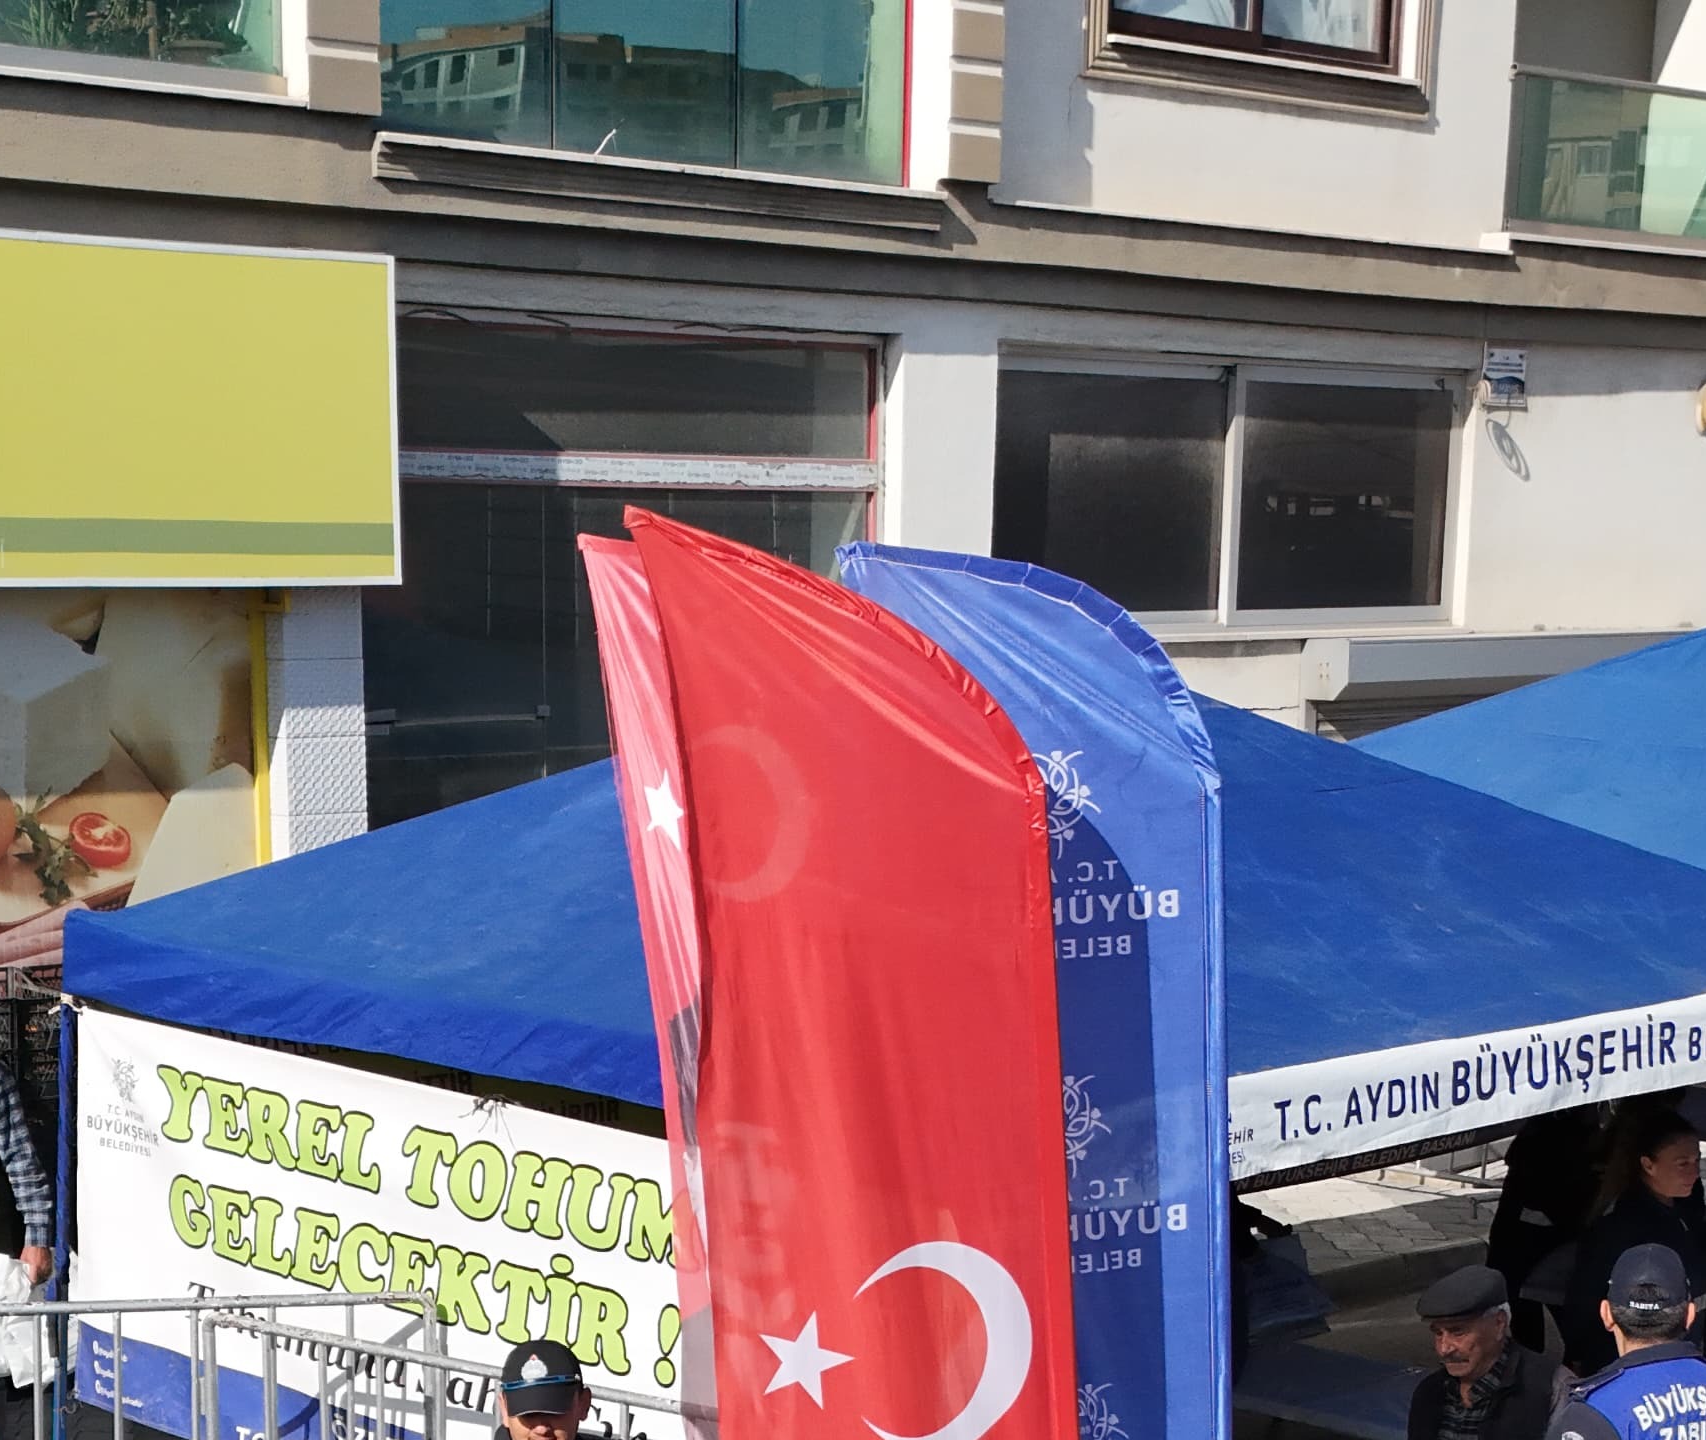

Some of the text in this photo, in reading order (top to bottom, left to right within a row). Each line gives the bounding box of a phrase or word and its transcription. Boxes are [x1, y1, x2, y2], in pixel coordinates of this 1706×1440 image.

[87, 1114, 160, 1148] BÜYÜKŞEHİR
[156, 1063, 381, 1194] YEREL
[1274, 1094, 1333, 1141] T.C.
[1344, 1072, 1440, 1129] AYDIN
[1451, 1014, 1677, 1107] BÜYÜKŞEHİR
[168, 1174, 631, 1376] GELECEKTİR
